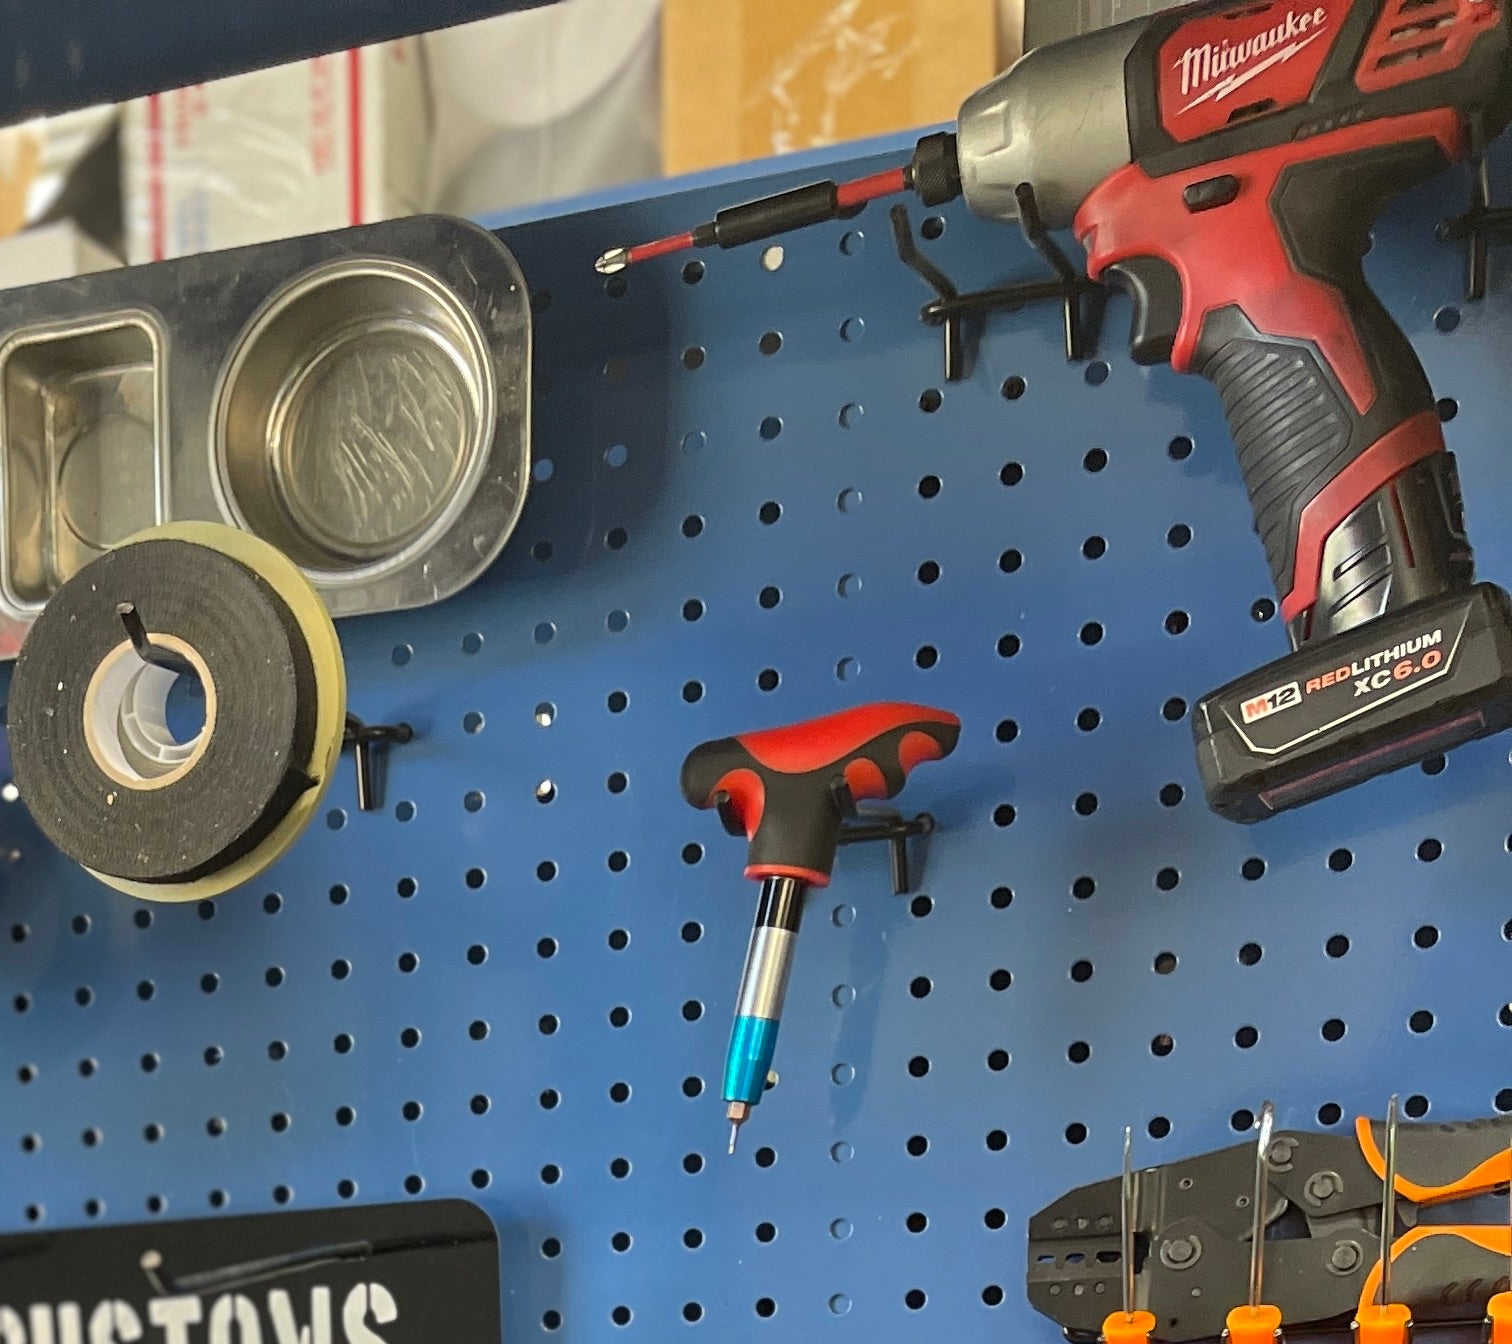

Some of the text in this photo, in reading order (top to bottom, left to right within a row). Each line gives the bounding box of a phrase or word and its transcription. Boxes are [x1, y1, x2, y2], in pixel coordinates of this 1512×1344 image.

[1173, 7, 1327, 95] Milwaukee
[1245, 629, 1442, 719] M12 REDLITHIUM
